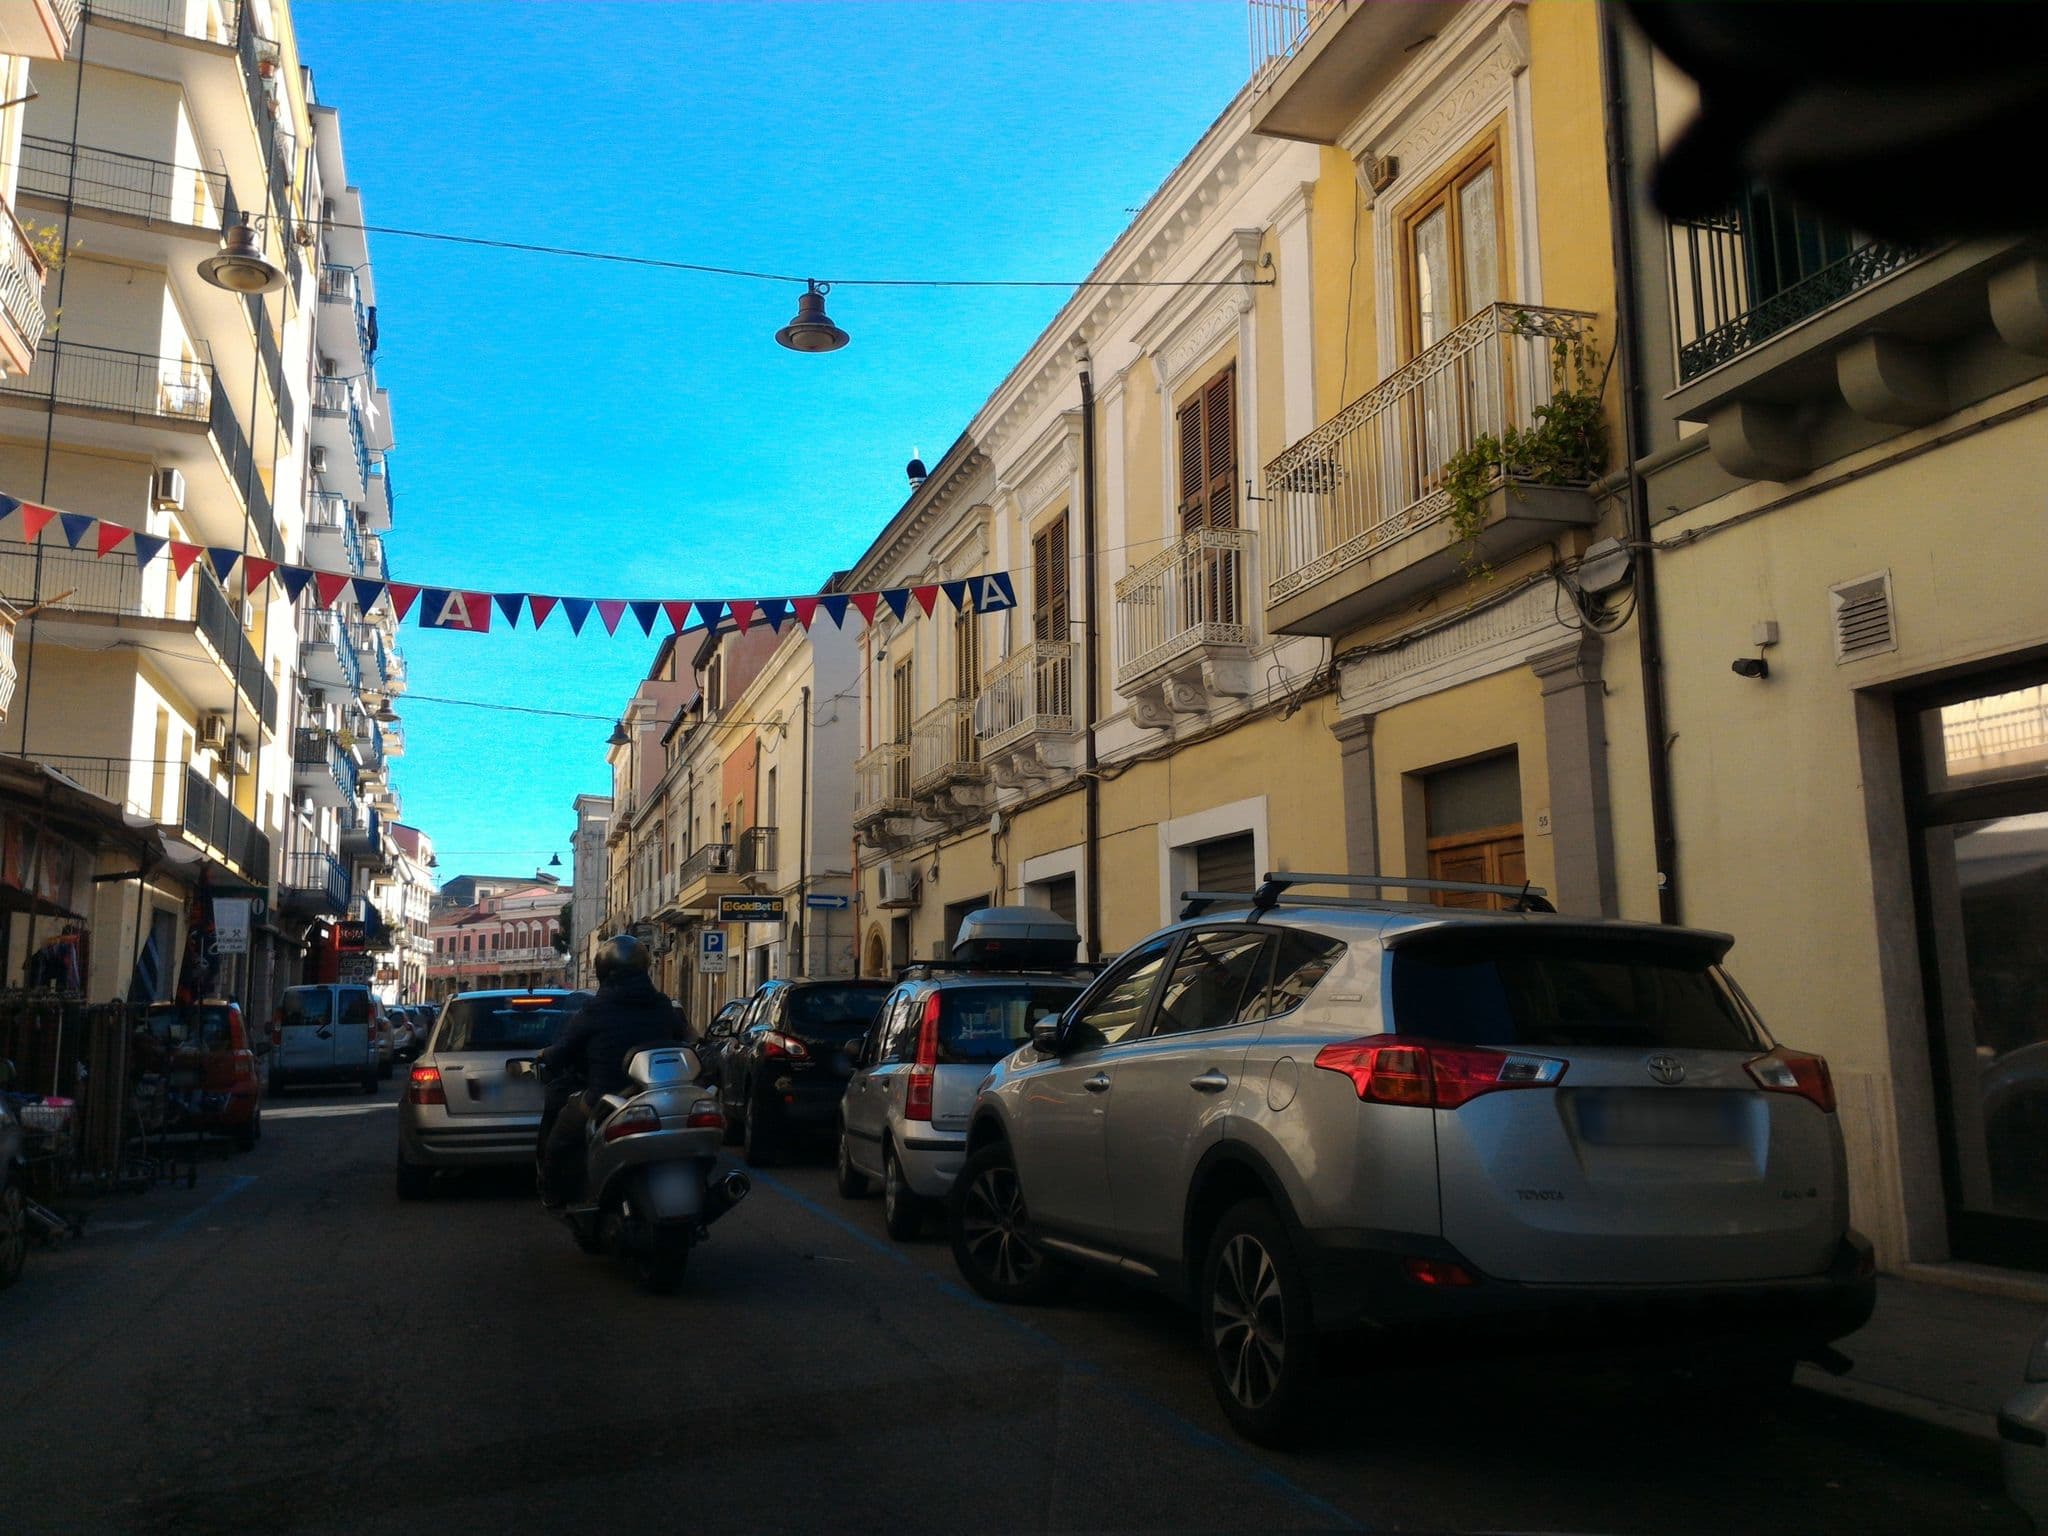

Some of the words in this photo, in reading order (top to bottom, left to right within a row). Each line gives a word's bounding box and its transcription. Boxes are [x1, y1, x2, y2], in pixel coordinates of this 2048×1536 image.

[981, 576, 1011, 611] A
[435, 591, 472, 628] A
[733, 902, 771, 911] GoldBet
[708, 935, 719, 950] P
